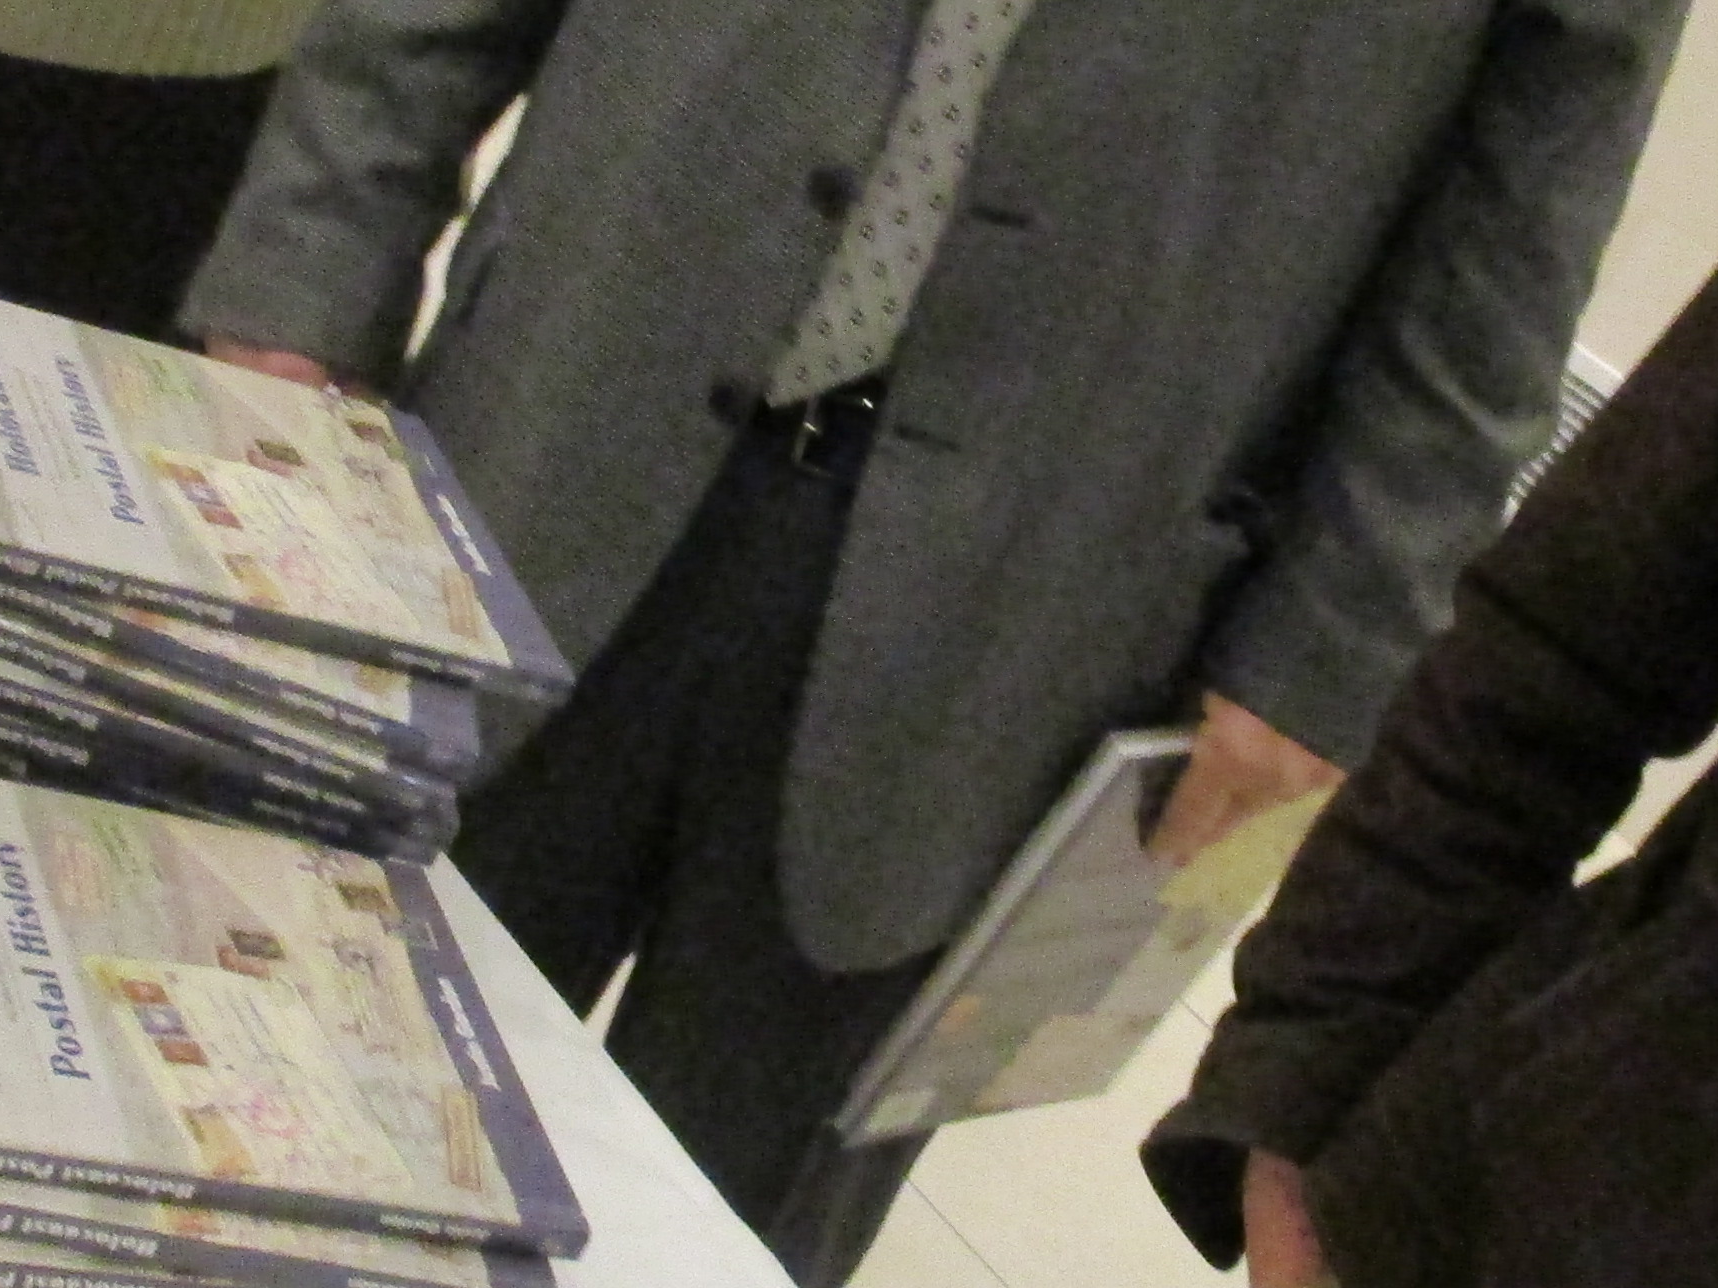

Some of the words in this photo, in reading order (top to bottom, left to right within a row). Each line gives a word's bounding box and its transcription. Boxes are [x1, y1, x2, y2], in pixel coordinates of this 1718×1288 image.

[54, 353, 107, 441] History
[83, 444, 145, 525] Postal
[20, 965, 92, 1081] Postal
[62, 1164, 196, 1200] Holocaust
[20, 1215, 159, 1259] Holocaust
